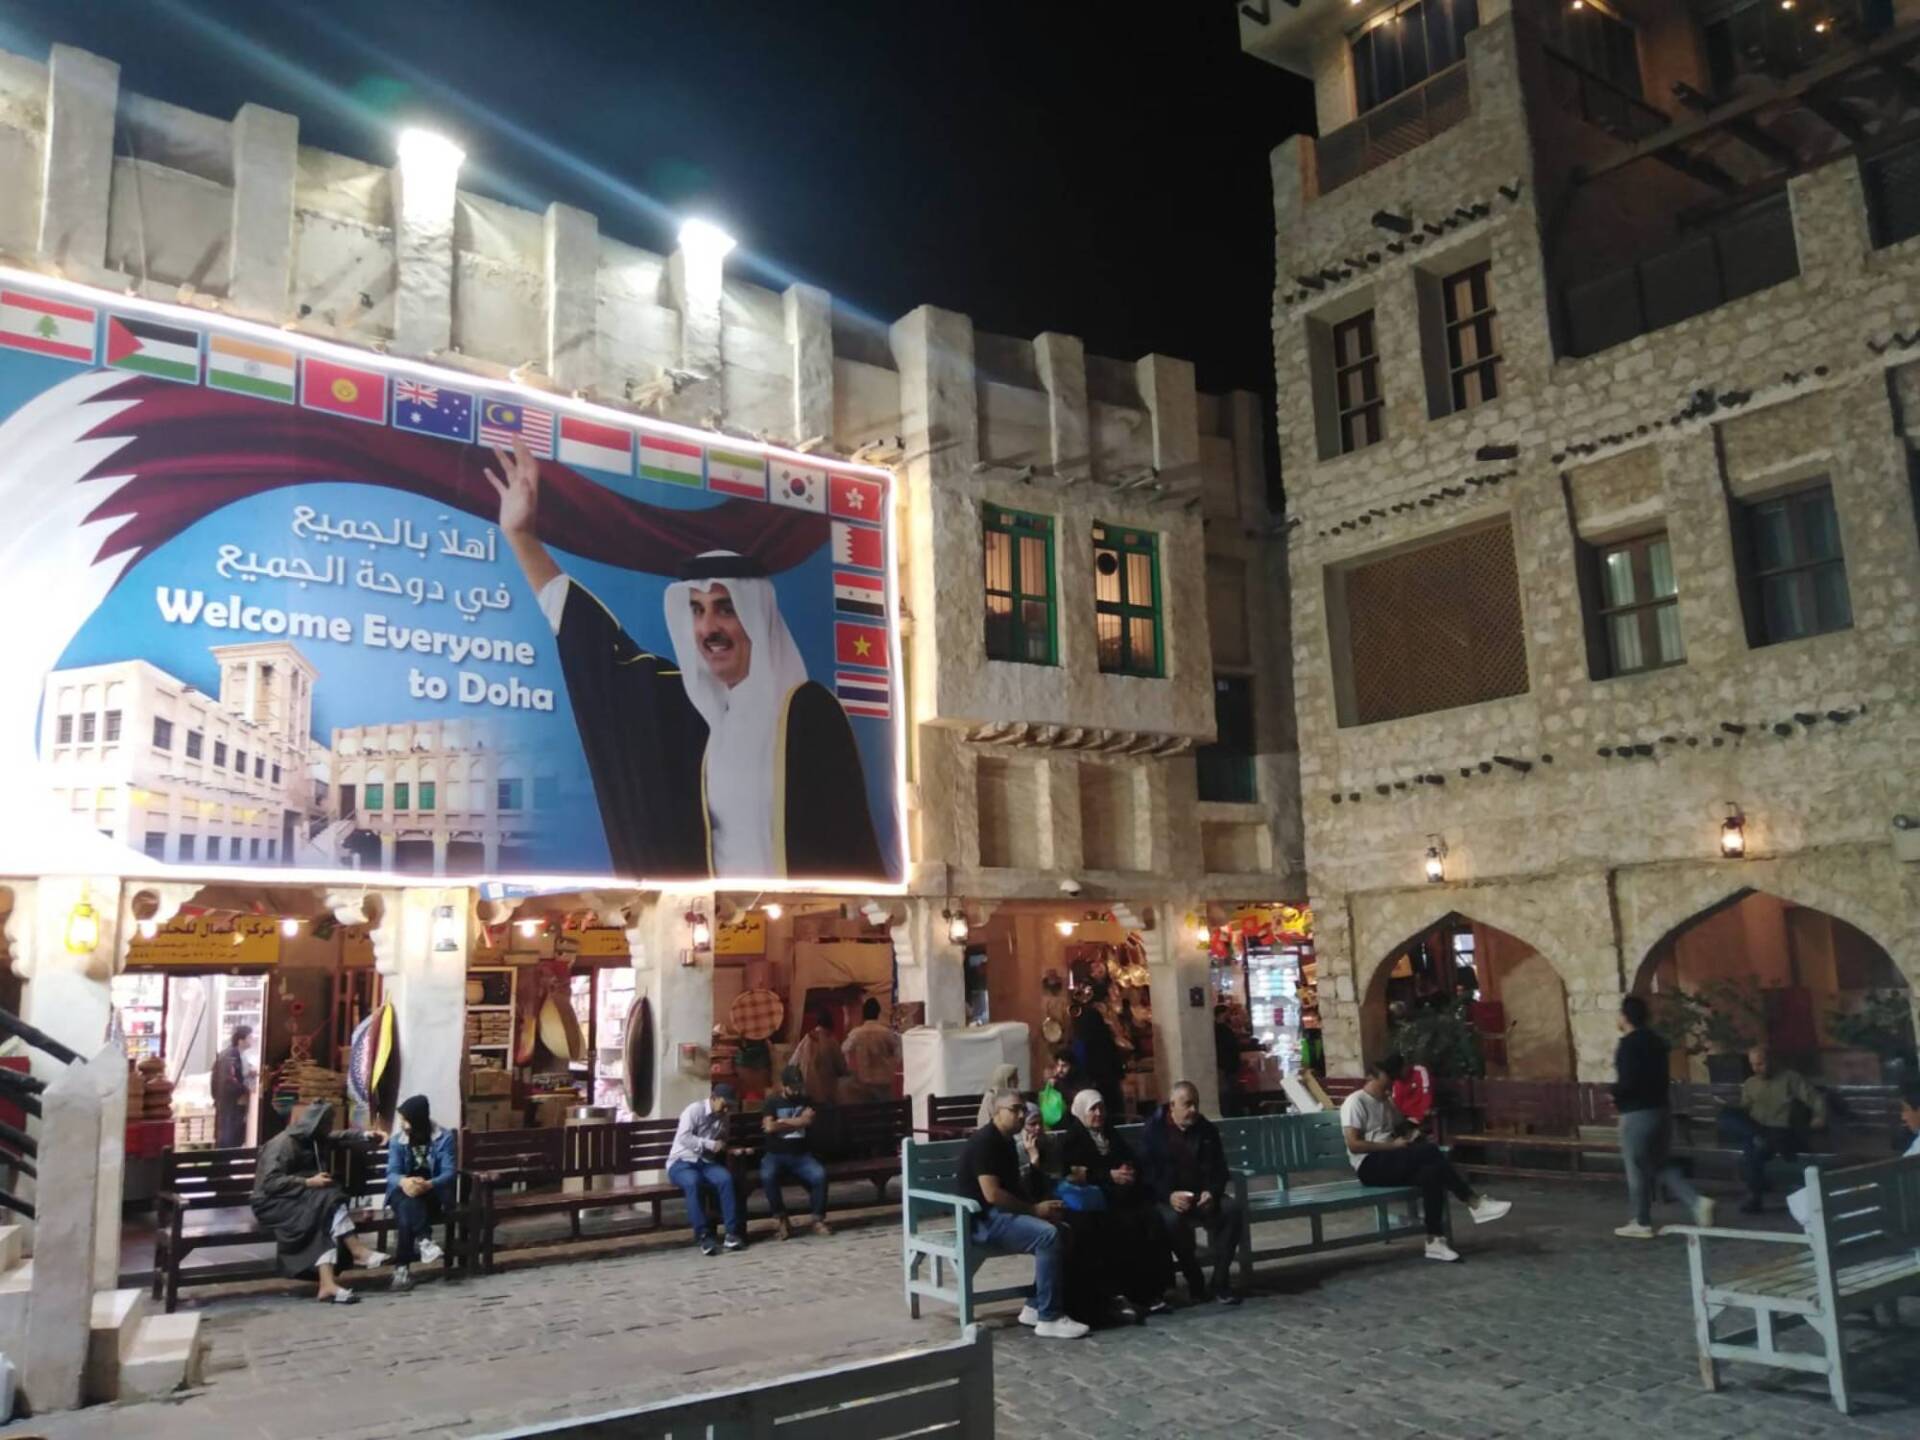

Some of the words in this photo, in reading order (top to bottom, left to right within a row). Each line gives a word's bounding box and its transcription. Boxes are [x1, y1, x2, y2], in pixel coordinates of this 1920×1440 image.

[292, 505, 428, 558] بالجميع
[216, 544, 345, 588] الجميع
[356, 559, 444, 605] دوحة
[454, 582, 511, 622] في
[156, 586, 352, 642] Welcome
[363, 613, 535, 665] Everyone
[409, 668, 448, 700] to
[459, 671, 554, 711] Doha
